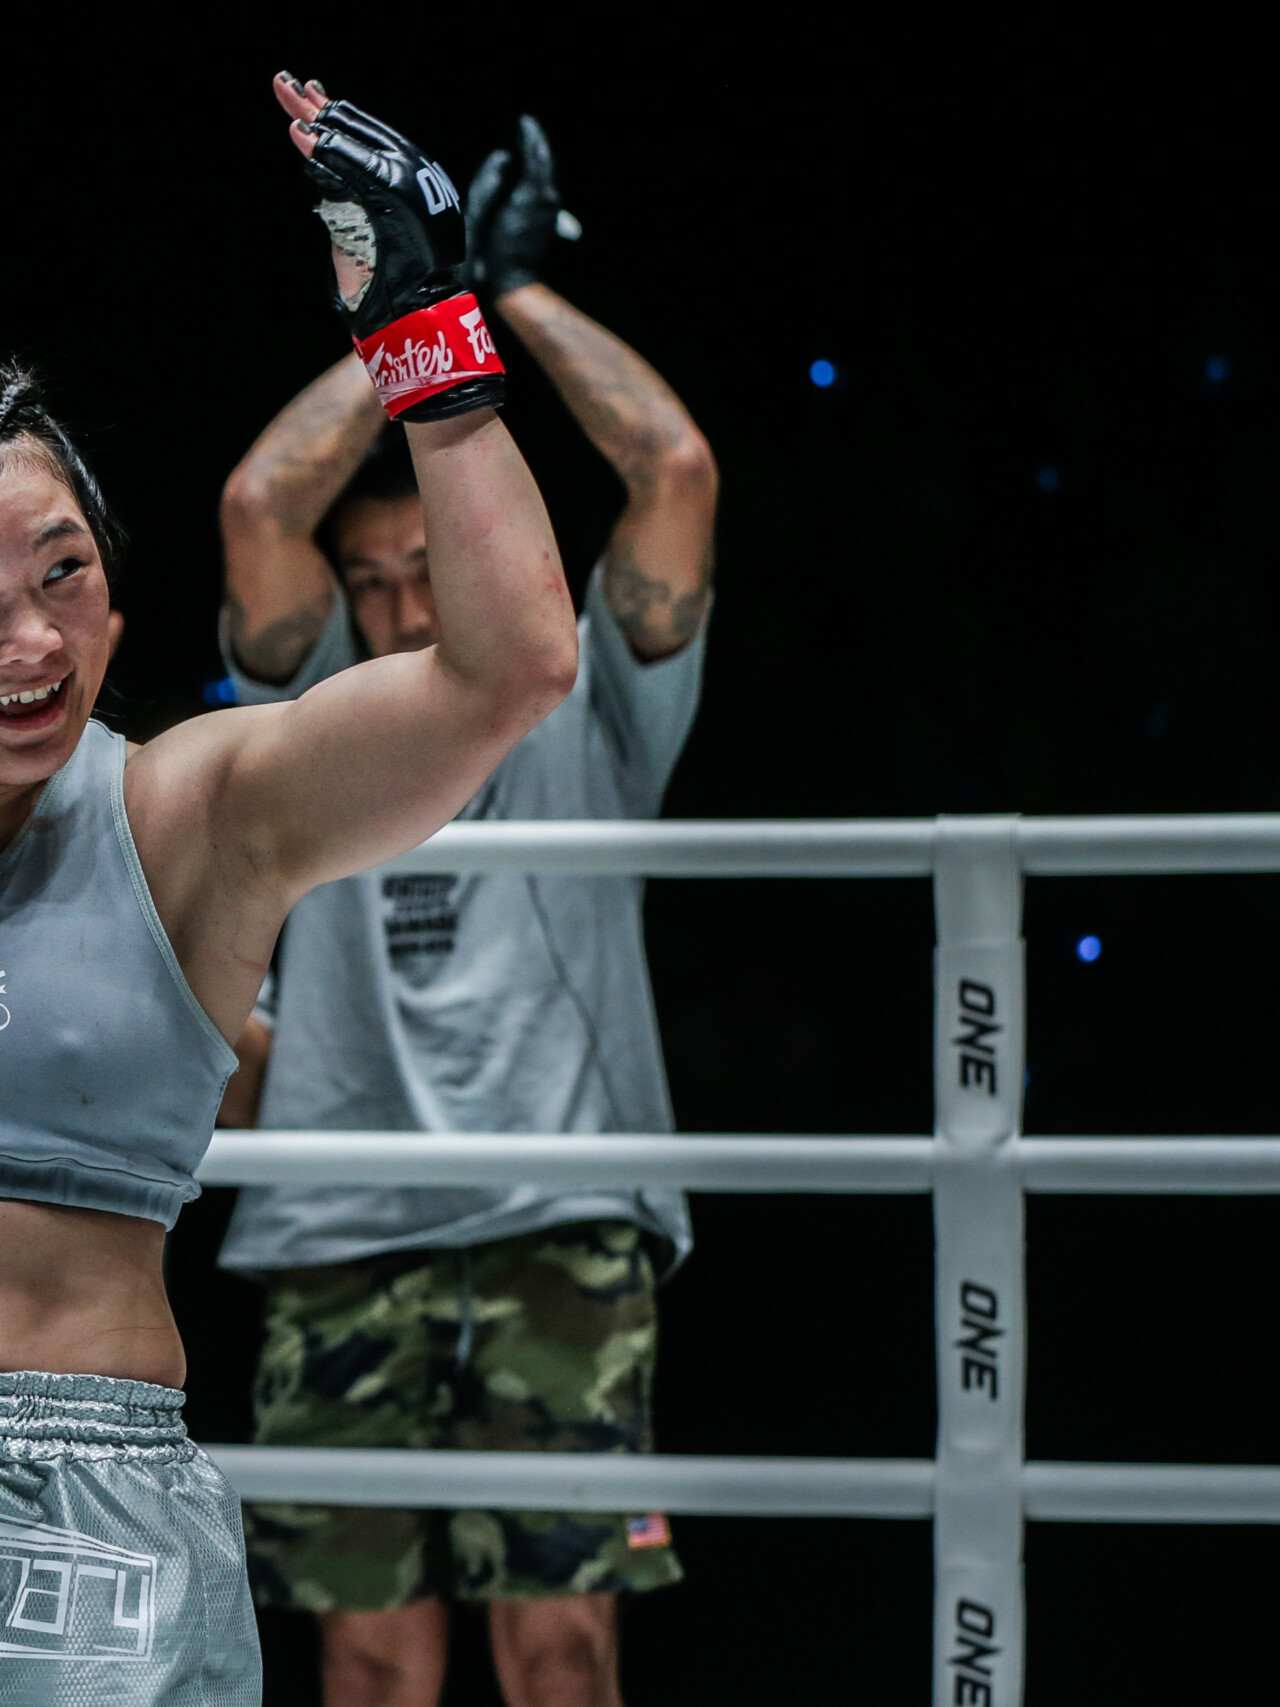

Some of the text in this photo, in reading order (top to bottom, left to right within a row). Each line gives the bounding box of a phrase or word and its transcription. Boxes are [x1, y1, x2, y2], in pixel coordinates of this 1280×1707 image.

[416, 156, 461, 215] ON
[952, 977, 1005, 1097] ONE
[954, 1280, 1006, 1401] ONE
[949, 1597, 1003, 1707] ONE
